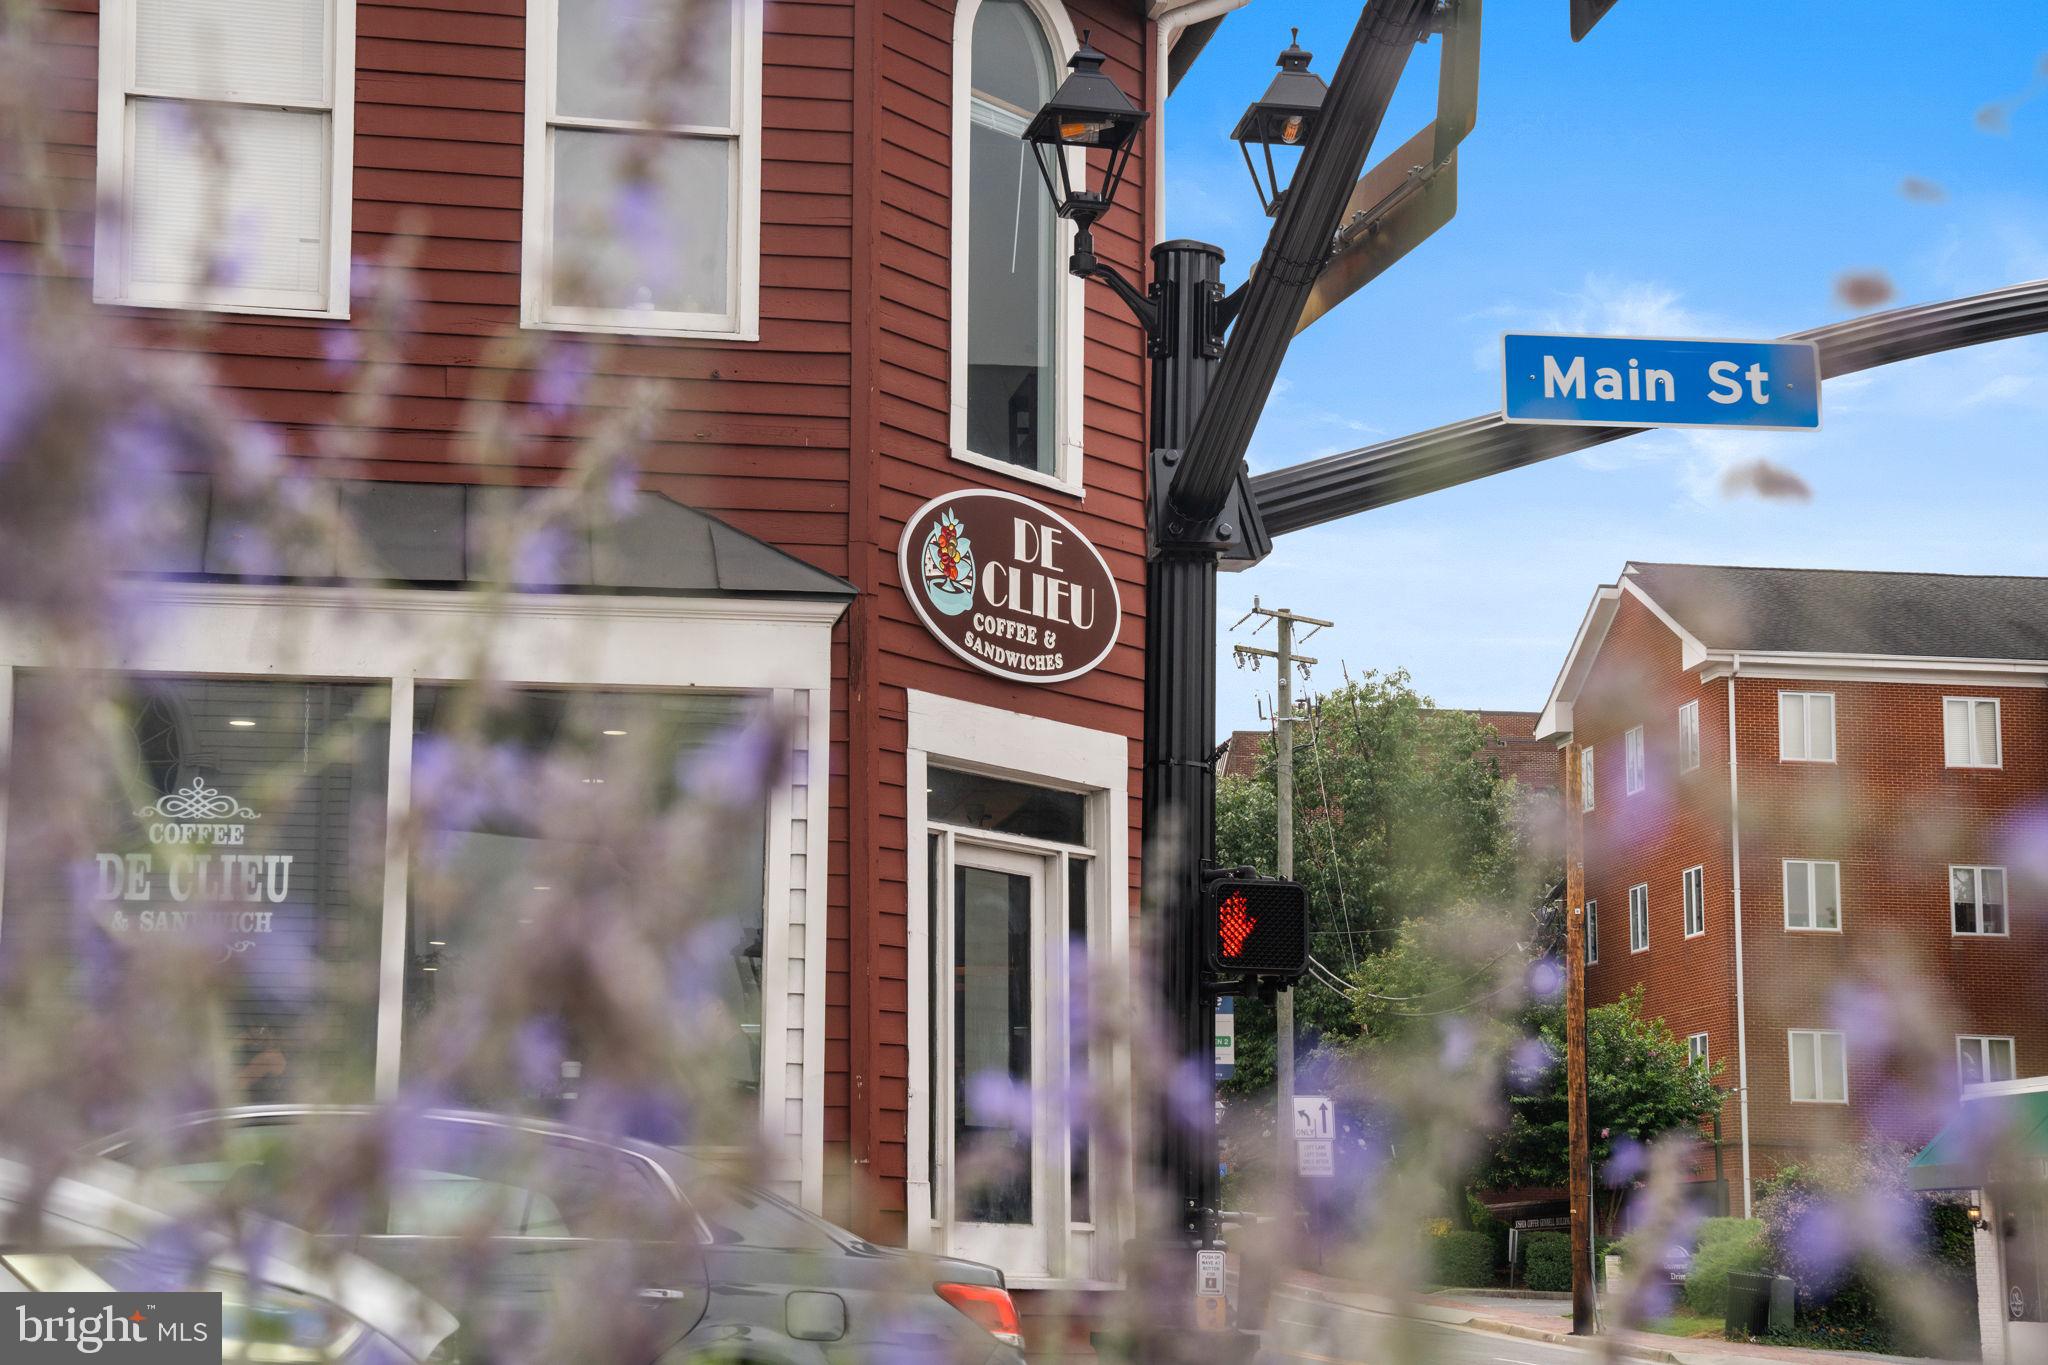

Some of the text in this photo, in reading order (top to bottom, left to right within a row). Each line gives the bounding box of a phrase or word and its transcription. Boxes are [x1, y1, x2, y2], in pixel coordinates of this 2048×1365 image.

[1543, 355, 1769, 405] Main St
[1014, 517, 1064, 573] DE
[982, 561, 1095, 630] CLIEU
[964, 631, 1064, 671] SANDWICHES
[973, 612, 1056, 649] COFFEE &
[149, 823, 245, 845] COFFEE
[96, 853, 293, 903] DE CLIEU
[111, 911, 273, 932] & SANICH
